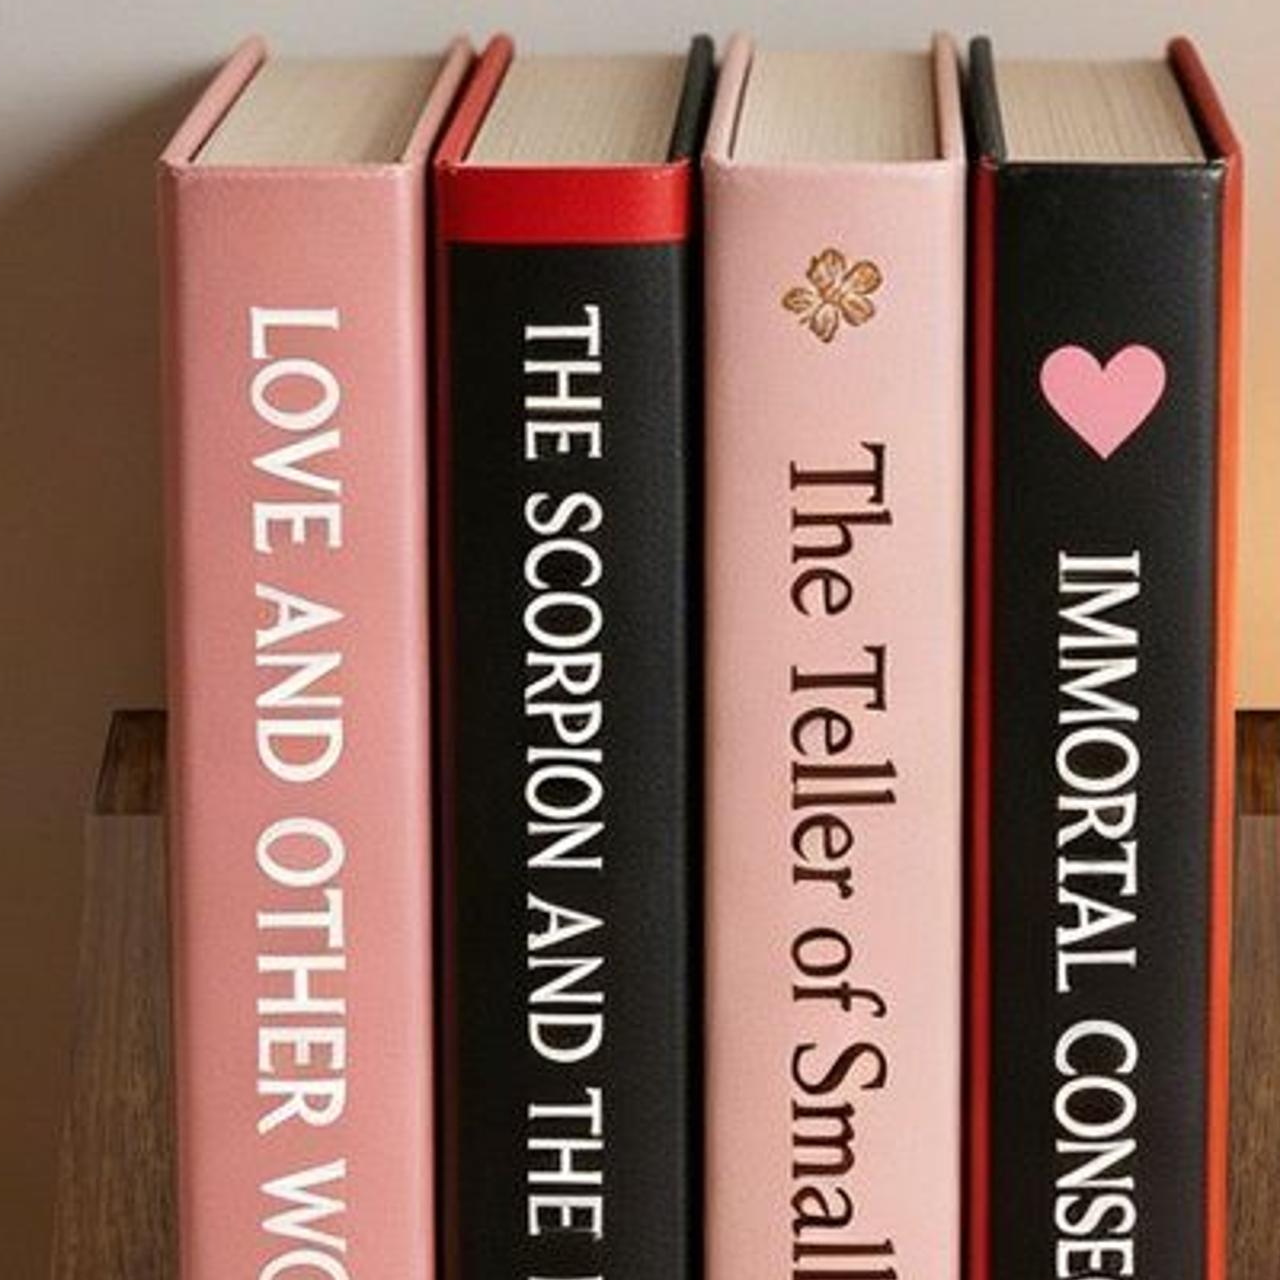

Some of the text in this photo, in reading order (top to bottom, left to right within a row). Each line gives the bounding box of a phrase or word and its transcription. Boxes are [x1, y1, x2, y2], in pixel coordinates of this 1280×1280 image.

[249, 305, 344, 555] LOVE
[522, 303, 604, 461] THE
[788, 440, 894, 617] The
[254, 581, 345, 784] AND
[522, 491, 606, 870] SCORPION
[789, 643, 899, 901] Teller
[1054, 549, 1142, 994] IMMORTAL
[254, 816, 348, 1134] OTHER
[526, 891, 606, 1064] AND
[789, 926, 888, 1020] of
[526, 1086, 605, 1241] THE
